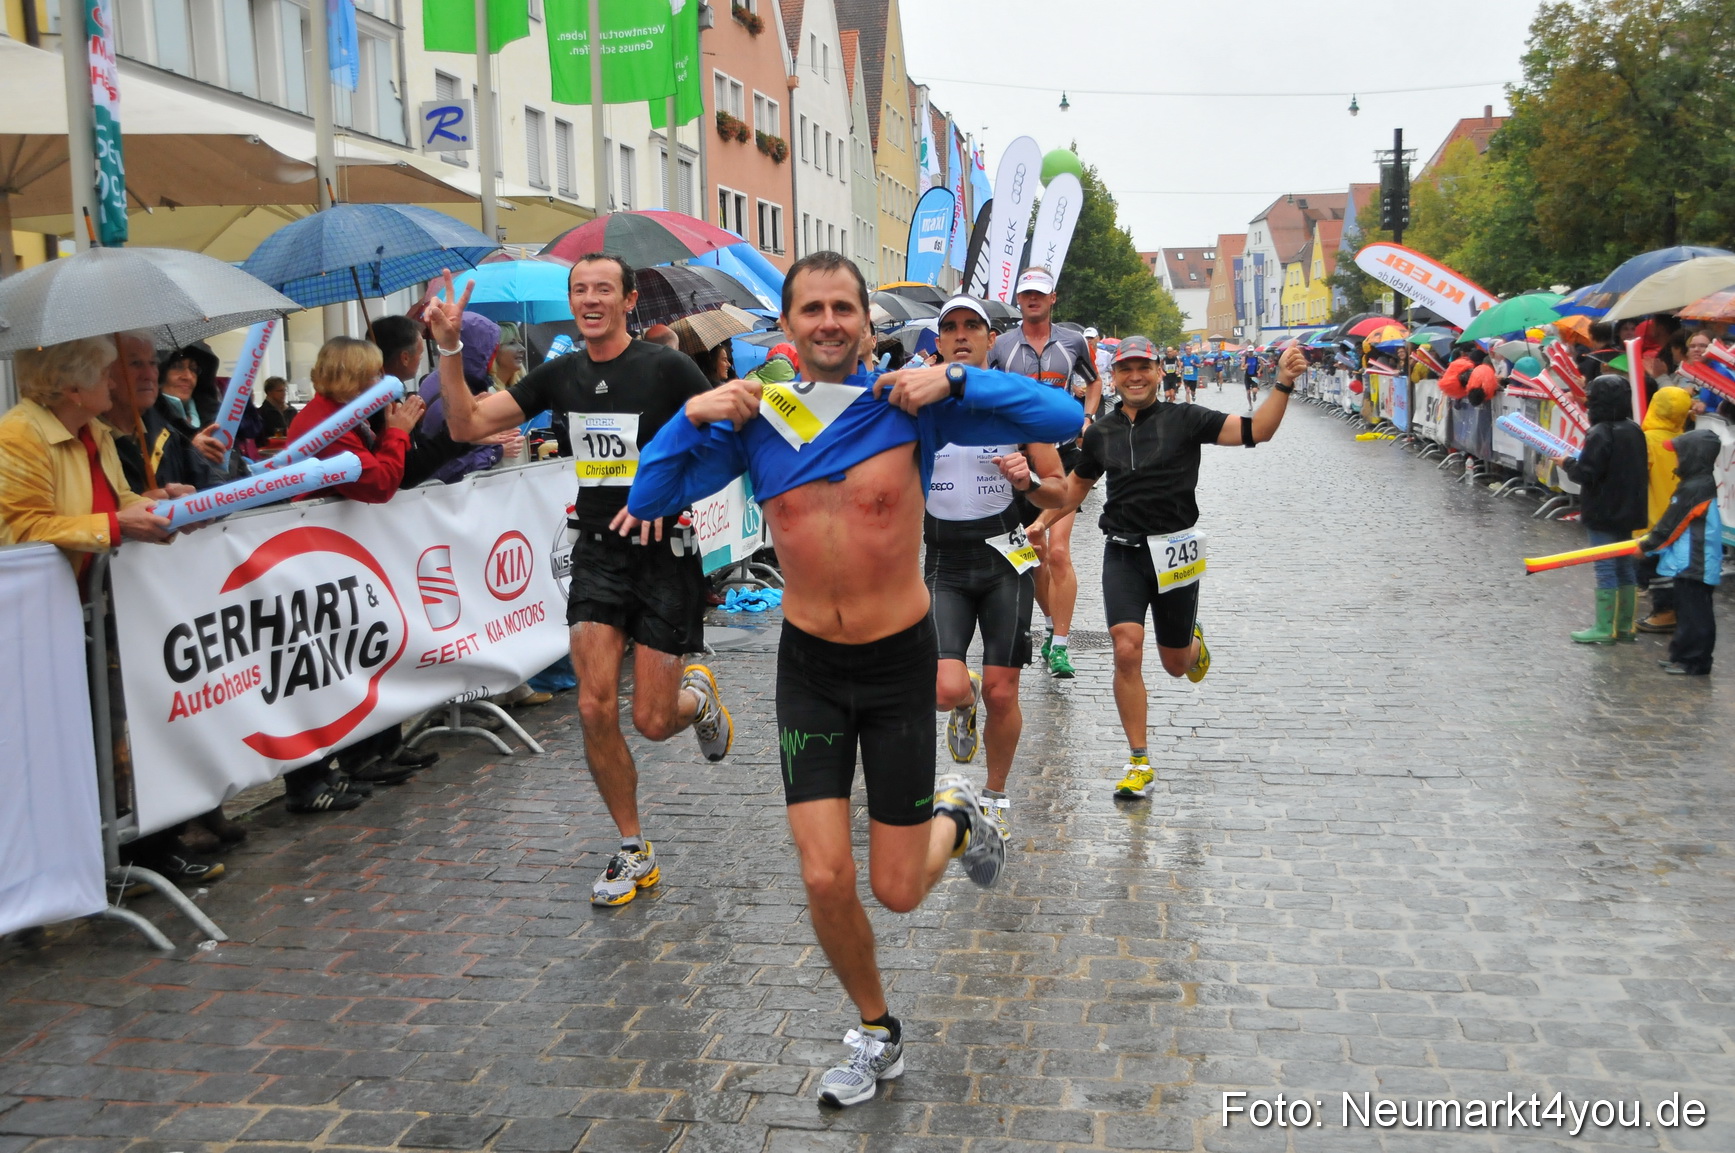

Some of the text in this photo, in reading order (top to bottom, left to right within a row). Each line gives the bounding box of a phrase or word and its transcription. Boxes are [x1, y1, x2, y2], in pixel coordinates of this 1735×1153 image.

[921, 213, 946, 233] maxi
[933, 239, 944, 252] dsl
[998, 218, 1017, 303] Audi BKK
[1044, 241, 1057, 273] BKK
[227, 320, 276, 423] TUI ReiseCente
[762, 386, 797, 417] elmut
[297, 390, 394, 457] TUI ReiseCenter
[582, 433, 626, 458] 103
[586, 464, 627, 477] Christoph
[976, 475, 997, 483] Made
[186, 471, 306, 516] TUI ReiseCenter
[977, 483, 1006, 495] ITALY
[496, 545, 528, 587] KIA
[1165, 540, 1198, 569] 243
[1173, 566, 1195, 581] Robert
[163, 575, 380, 683] GERHART &
[485, 601, 545, 644] KIA MOTORS
[260, 620, 390, 705] JÄNIG
[416, 633, 480, 669] SEAT
[168, 664, 262, 723] Autohaus
